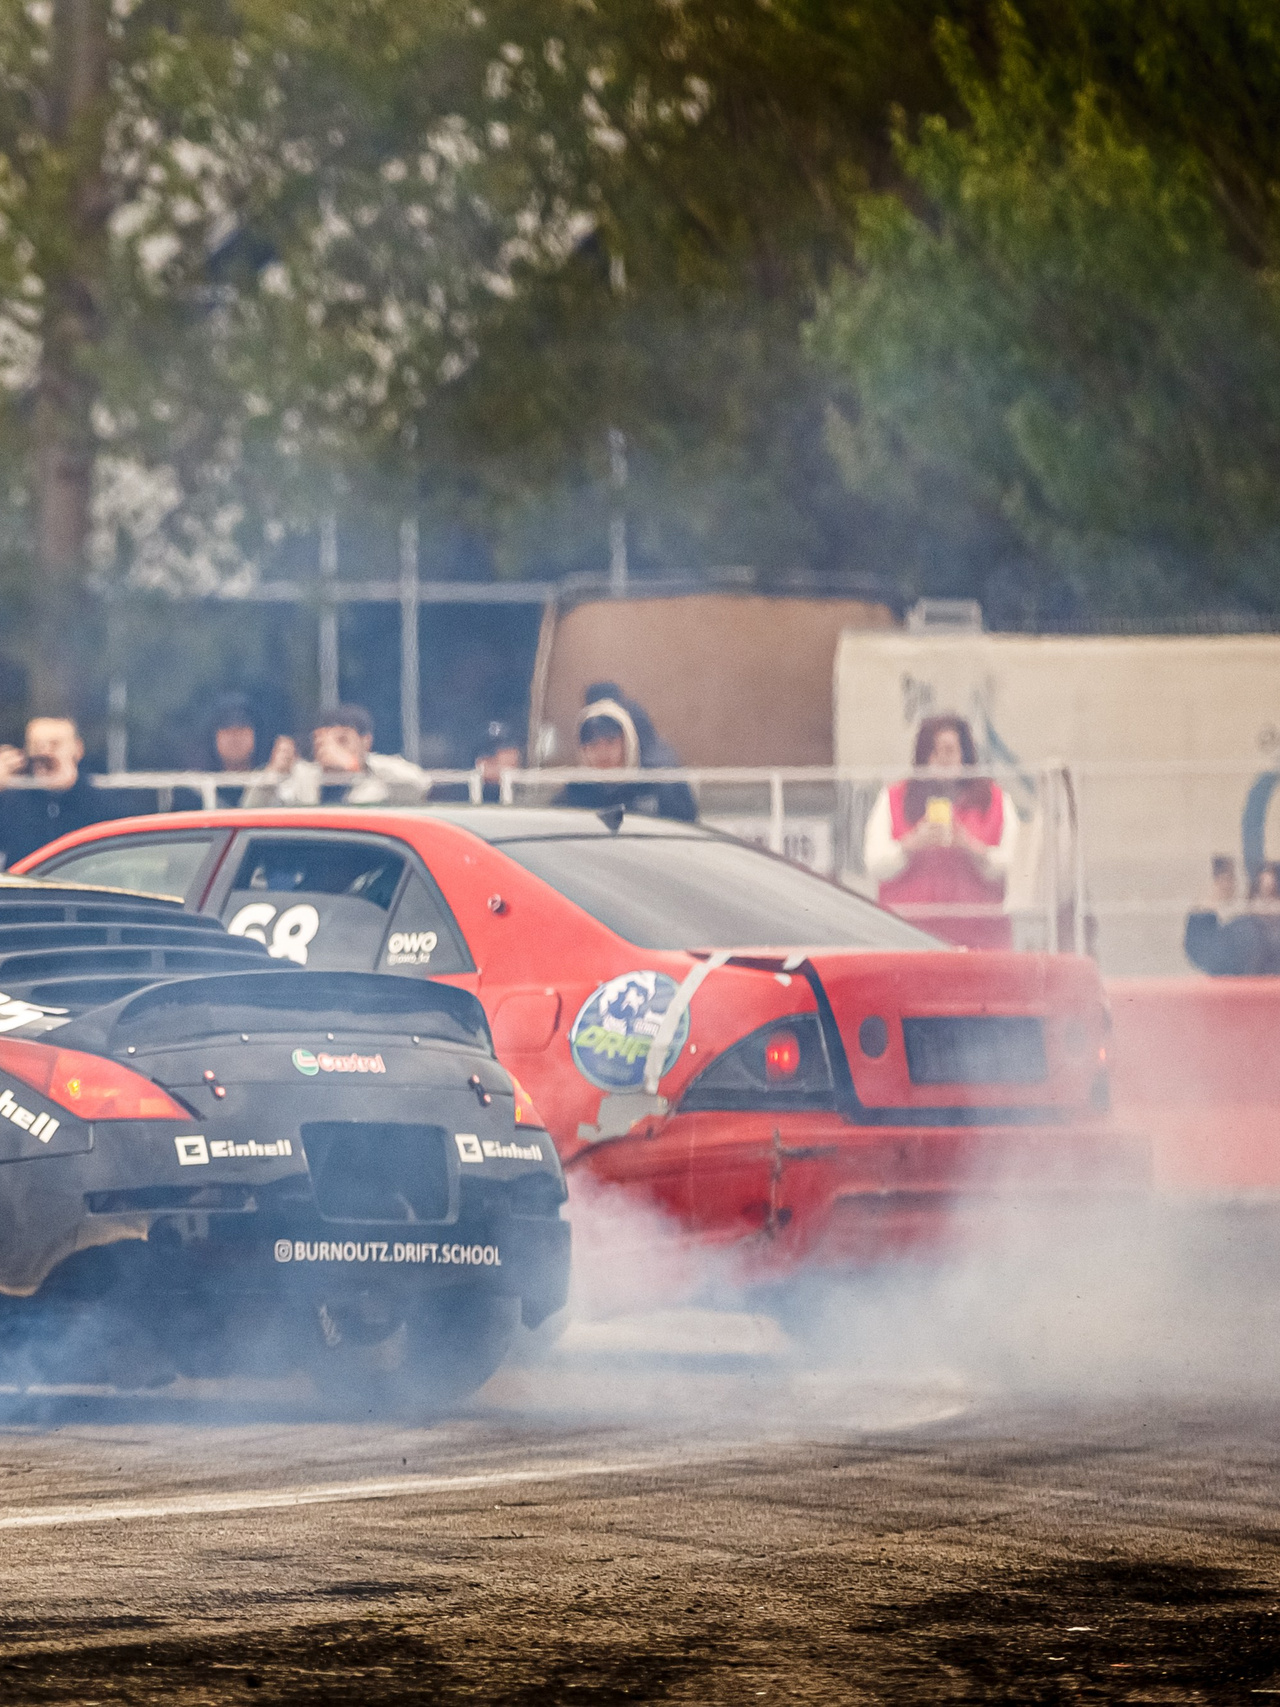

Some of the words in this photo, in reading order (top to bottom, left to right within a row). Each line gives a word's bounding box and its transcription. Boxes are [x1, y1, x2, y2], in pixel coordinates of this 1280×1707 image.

[575, 1025, 656, 1064] DRIF
[317, 1052, 386, 1073] Castrol
[210, 1139, 292, 1157] Einhell
[482, 1140, 543, 1161] Einhell
